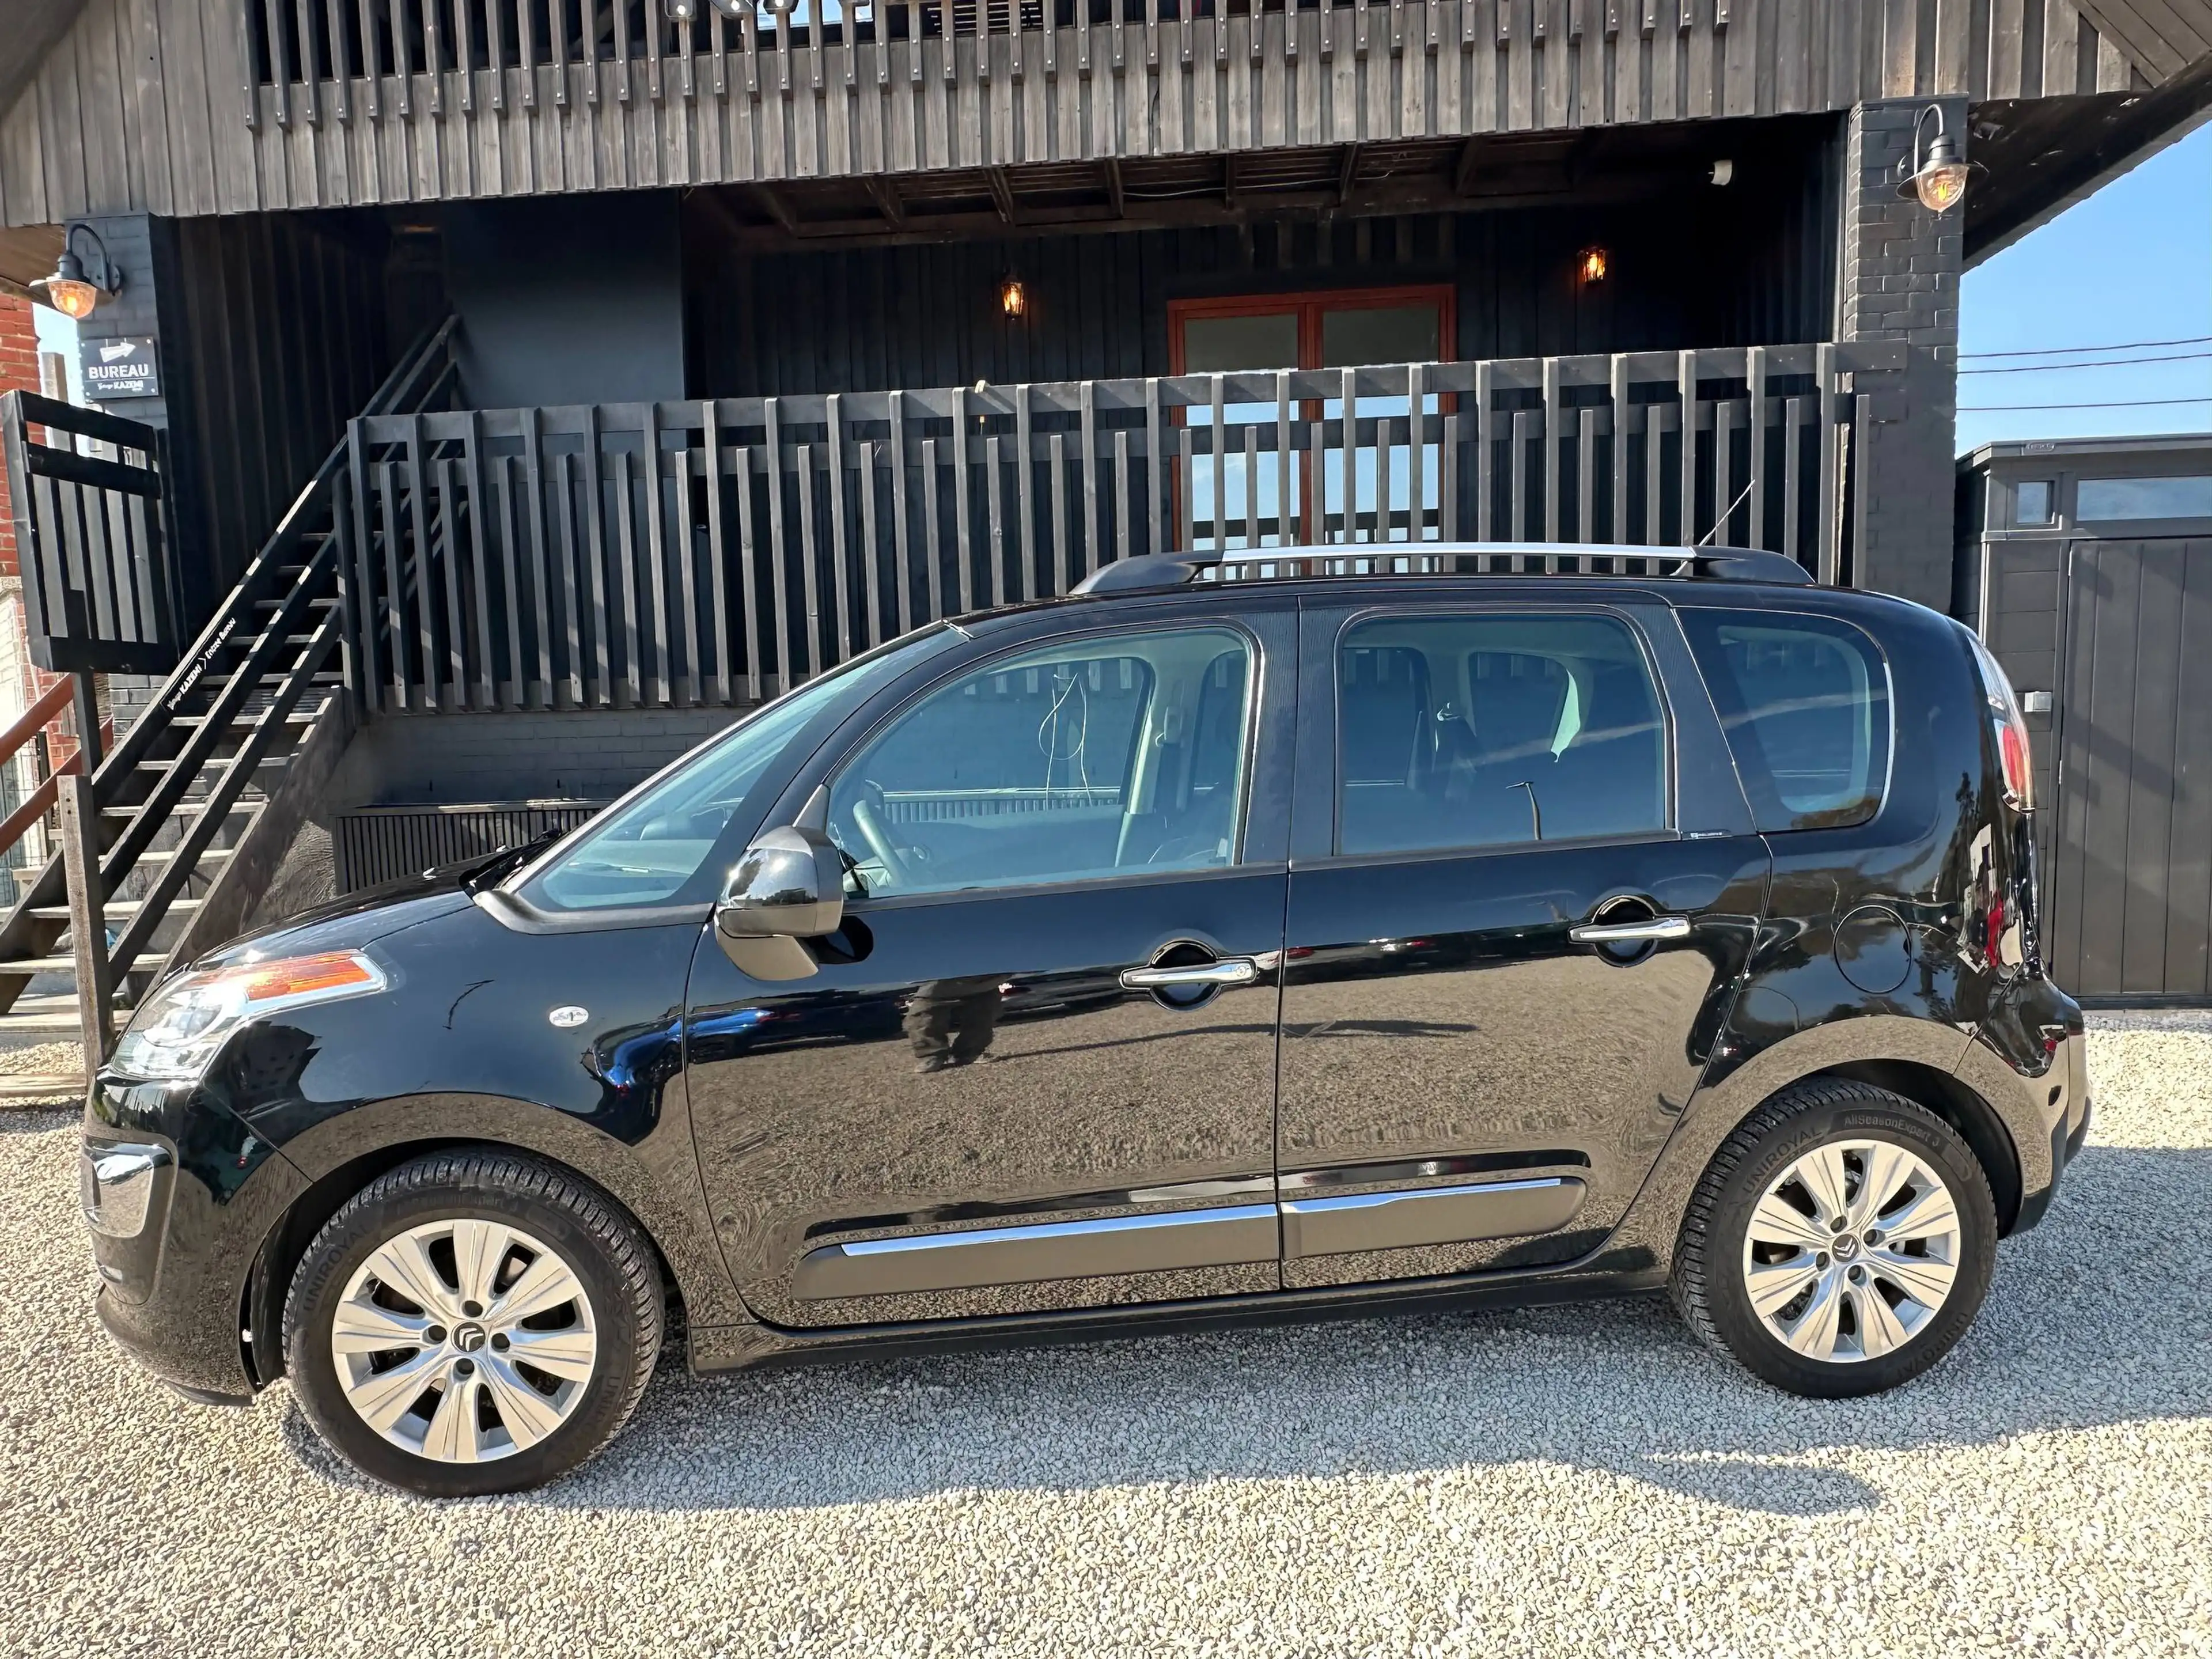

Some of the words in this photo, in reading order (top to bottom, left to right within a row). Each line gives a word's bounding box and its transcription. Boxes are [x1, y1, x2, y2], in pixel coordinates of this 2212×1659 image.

[89, 363, 149, 379] BUREAU
[1743, 1127, 1823, 1194] UNIROYAL
[302, 1224, 369, 1311] UNIROYAL
